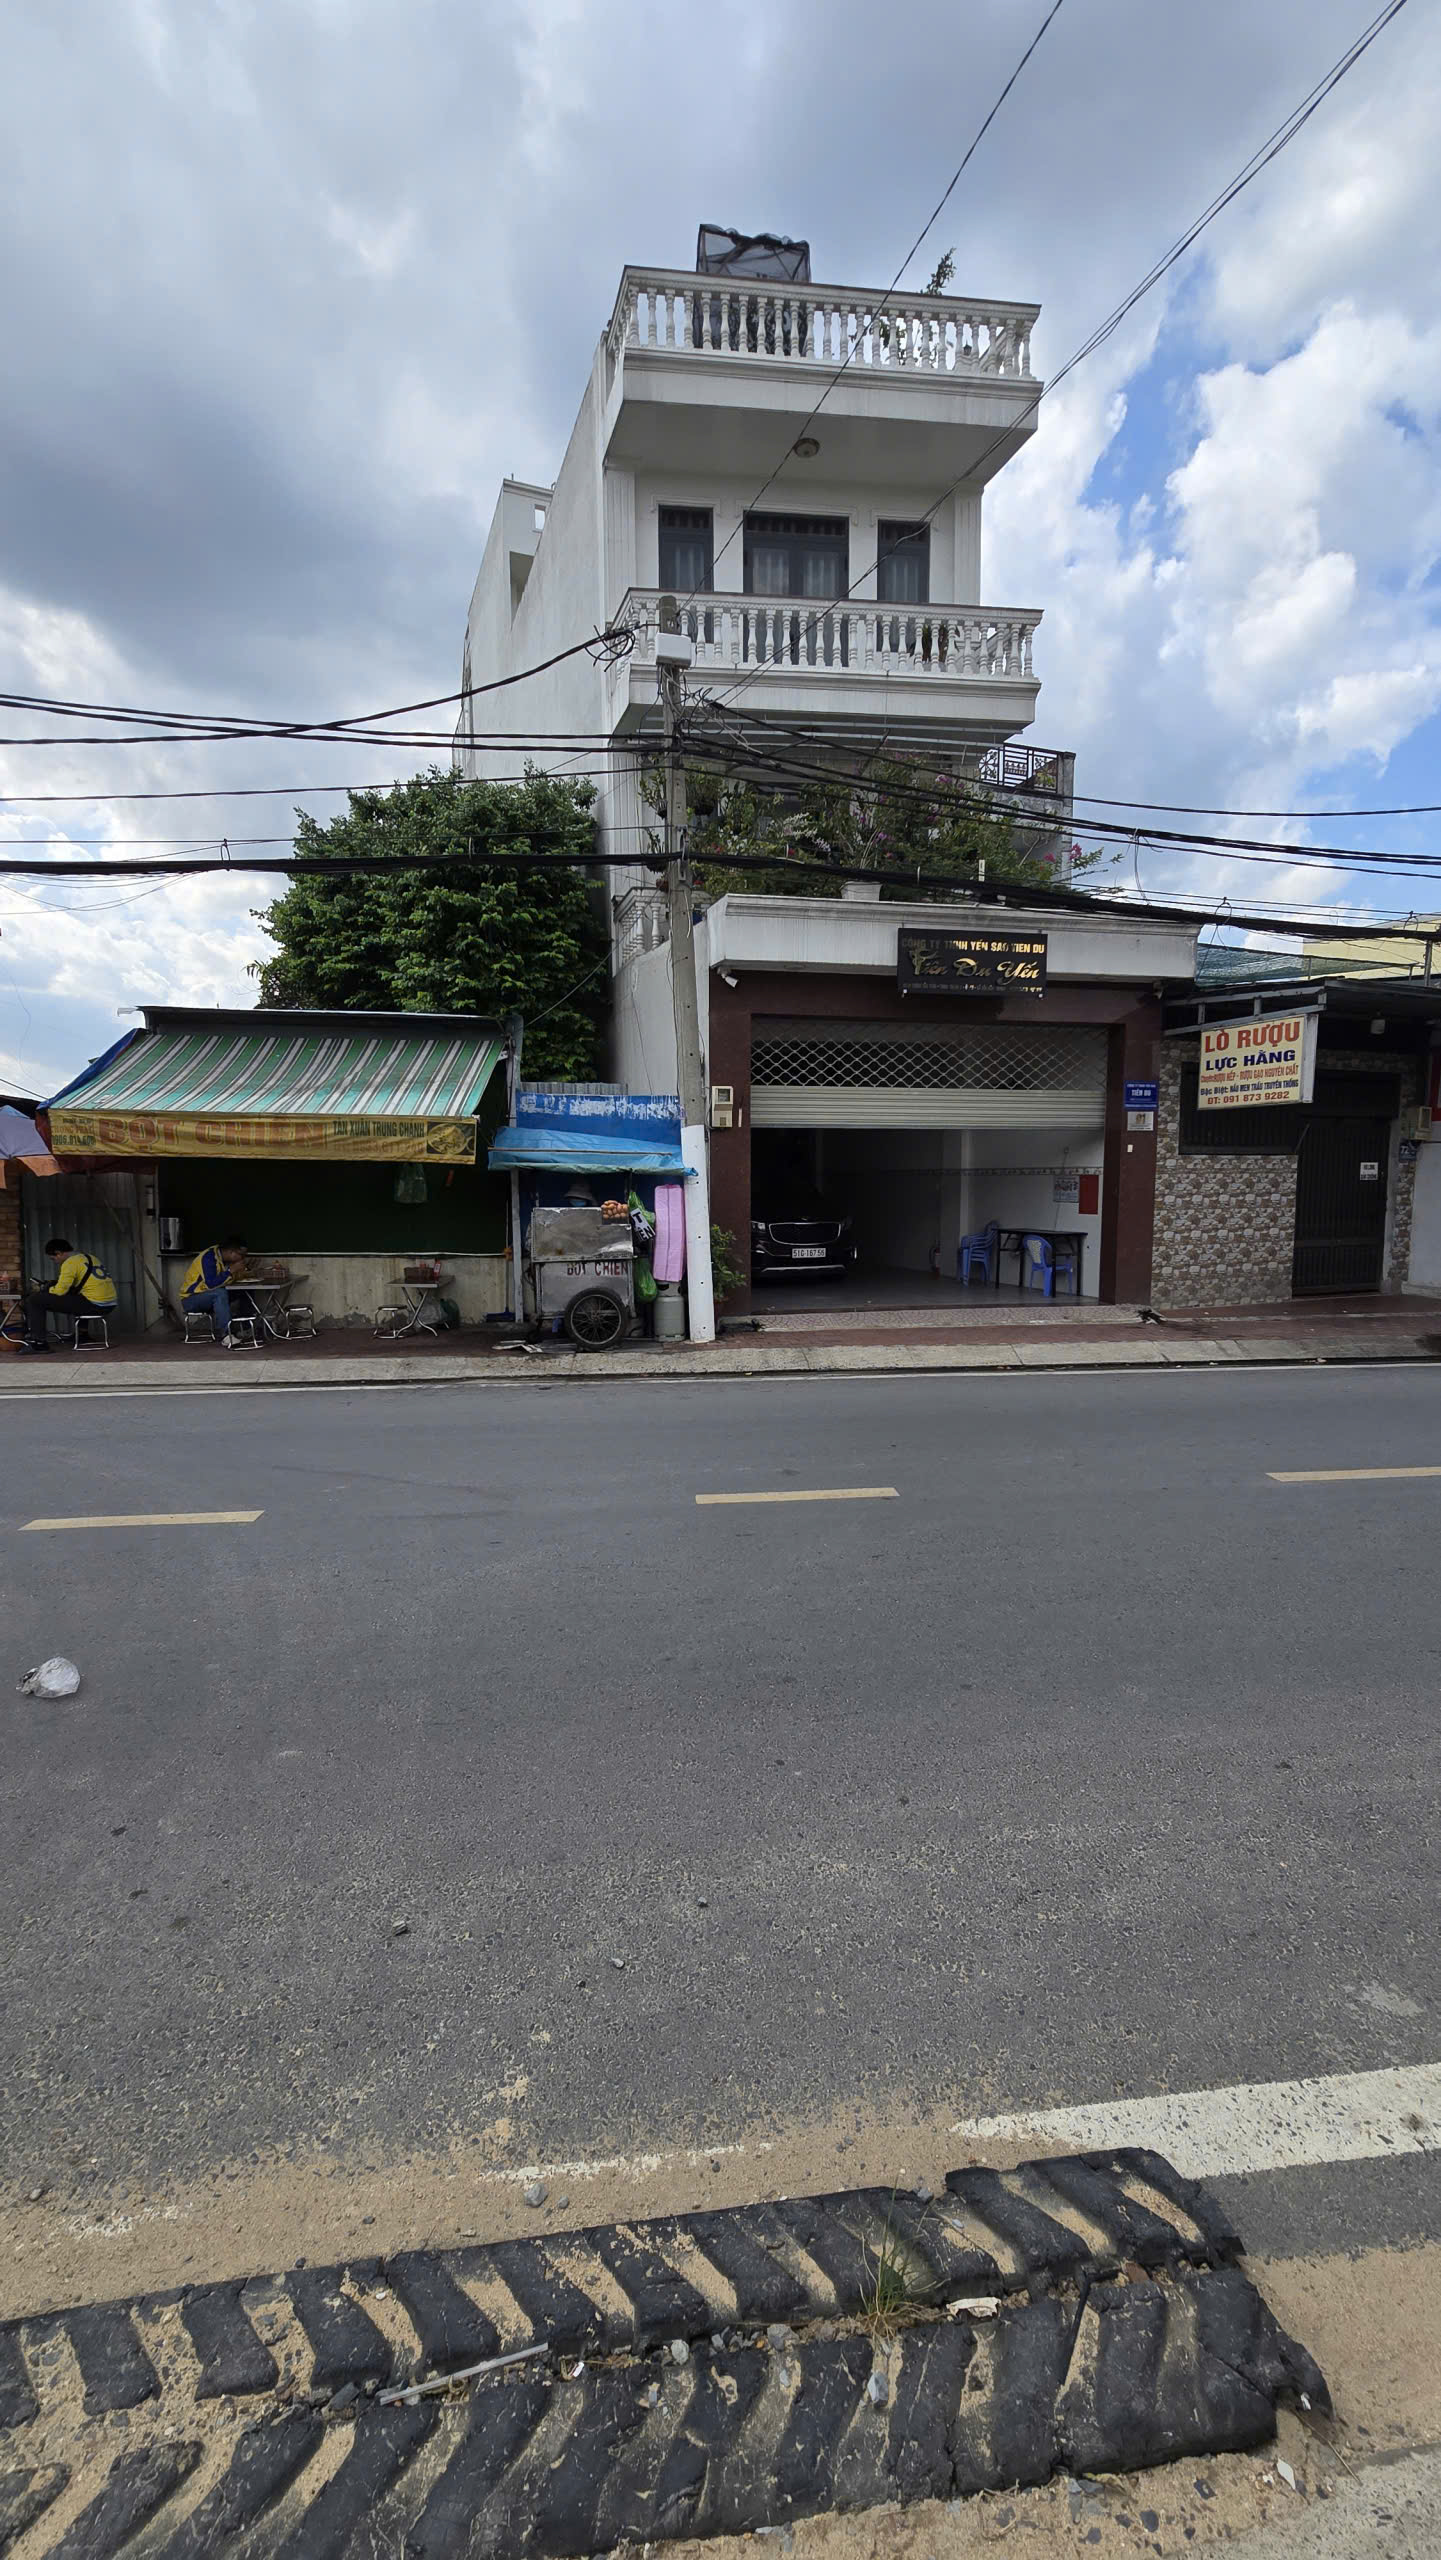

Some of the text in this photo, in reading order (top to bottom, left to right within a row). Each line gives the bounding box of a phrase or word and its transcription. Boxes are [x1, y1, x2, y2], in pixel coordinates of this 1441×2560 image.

[1205, 1021, 1300, 1053] LÒ RƯỢU
[1206, 1057, 1237, 1071] LỰC
[1223, 1095, 1239, 1104] 091
[1243, 1093, 1261, 1102] 873
[1264, 1091, 1290, 1100] 9282
[372, 1120, 398, 1137] TRUNG
